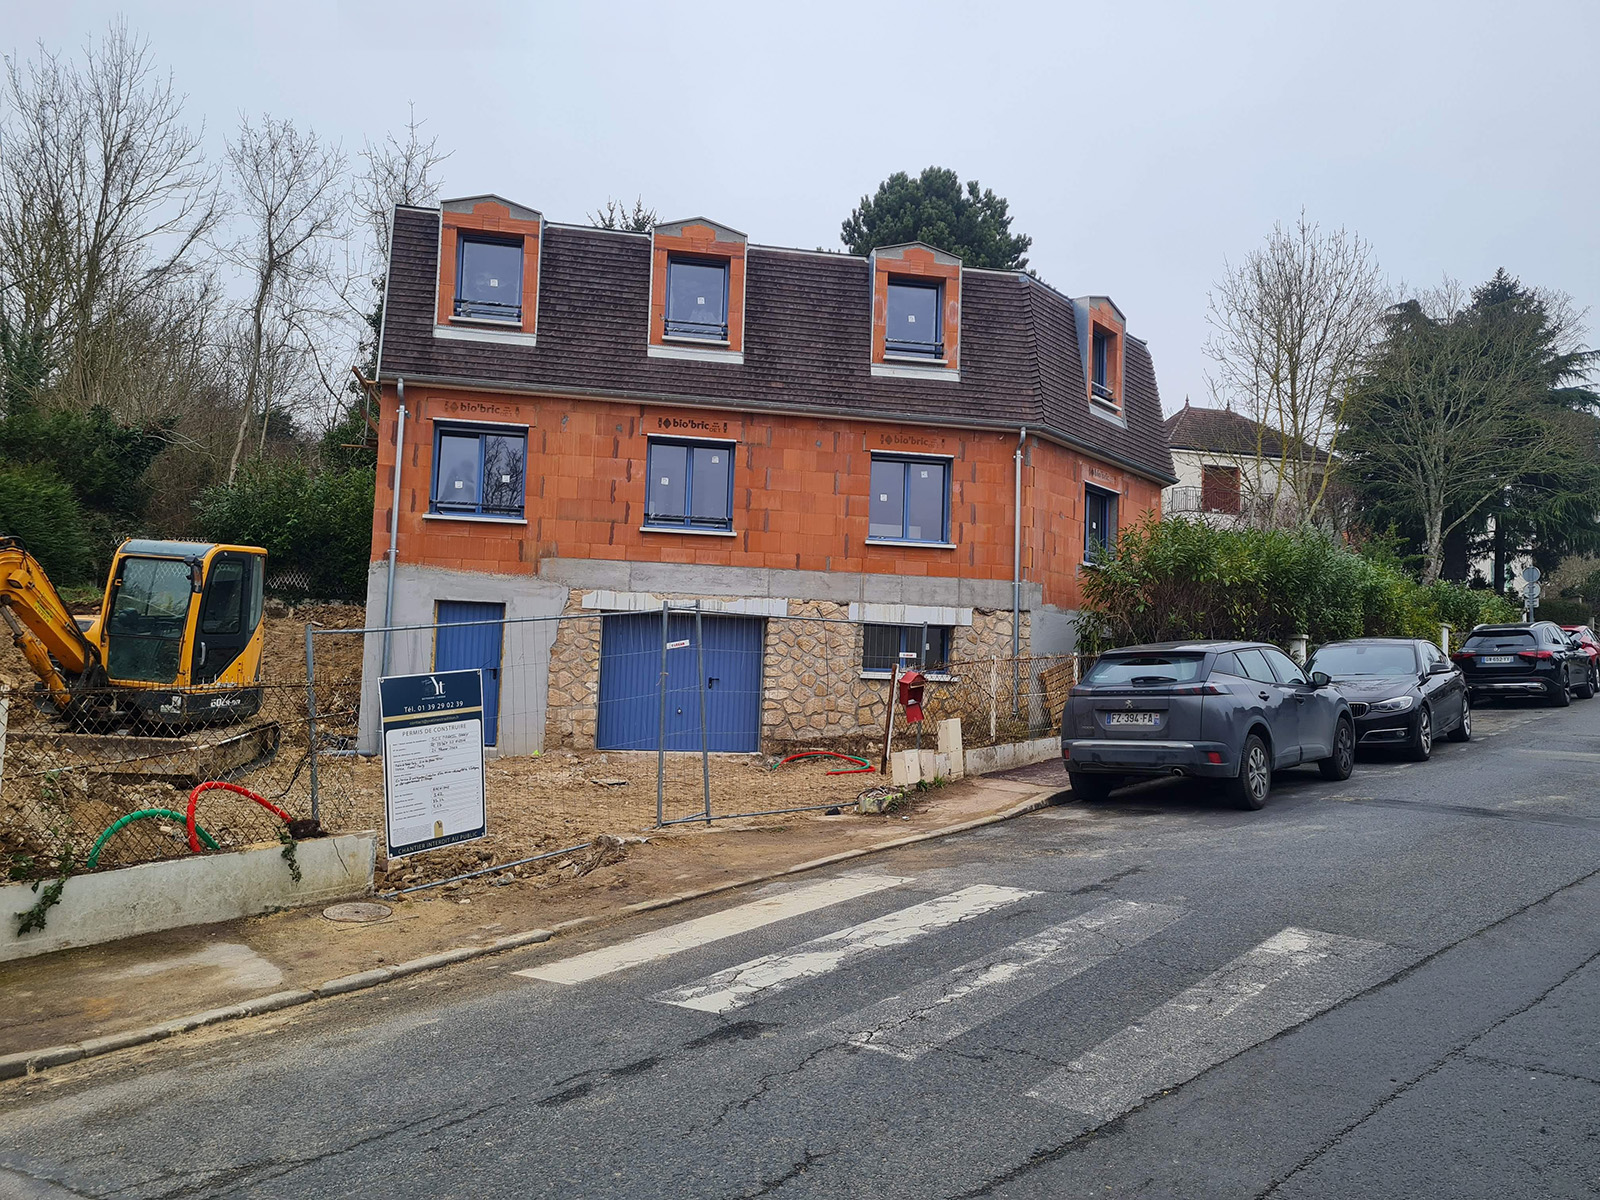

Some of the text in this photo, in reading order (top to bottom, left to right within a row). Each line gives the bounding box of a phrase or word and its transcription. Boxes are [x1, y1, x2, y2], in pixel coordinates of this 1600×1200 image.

[460, 402, 500, 414] bio'bric
[672, 418, 709, 430] bio'bric
[894, 435, 928, 446] bio'bric
[1111, 713, 1153, 723] FZ-394-FA
[402, 729, 423, 737] PERMIS
[433, 723, 466, 733] CONSTRUIRE
[398, 843, 426, 854] CHANTIER
[427, 838, 450, 848] INTERDIT
[459, 831, 478, 841] PUBLIC
